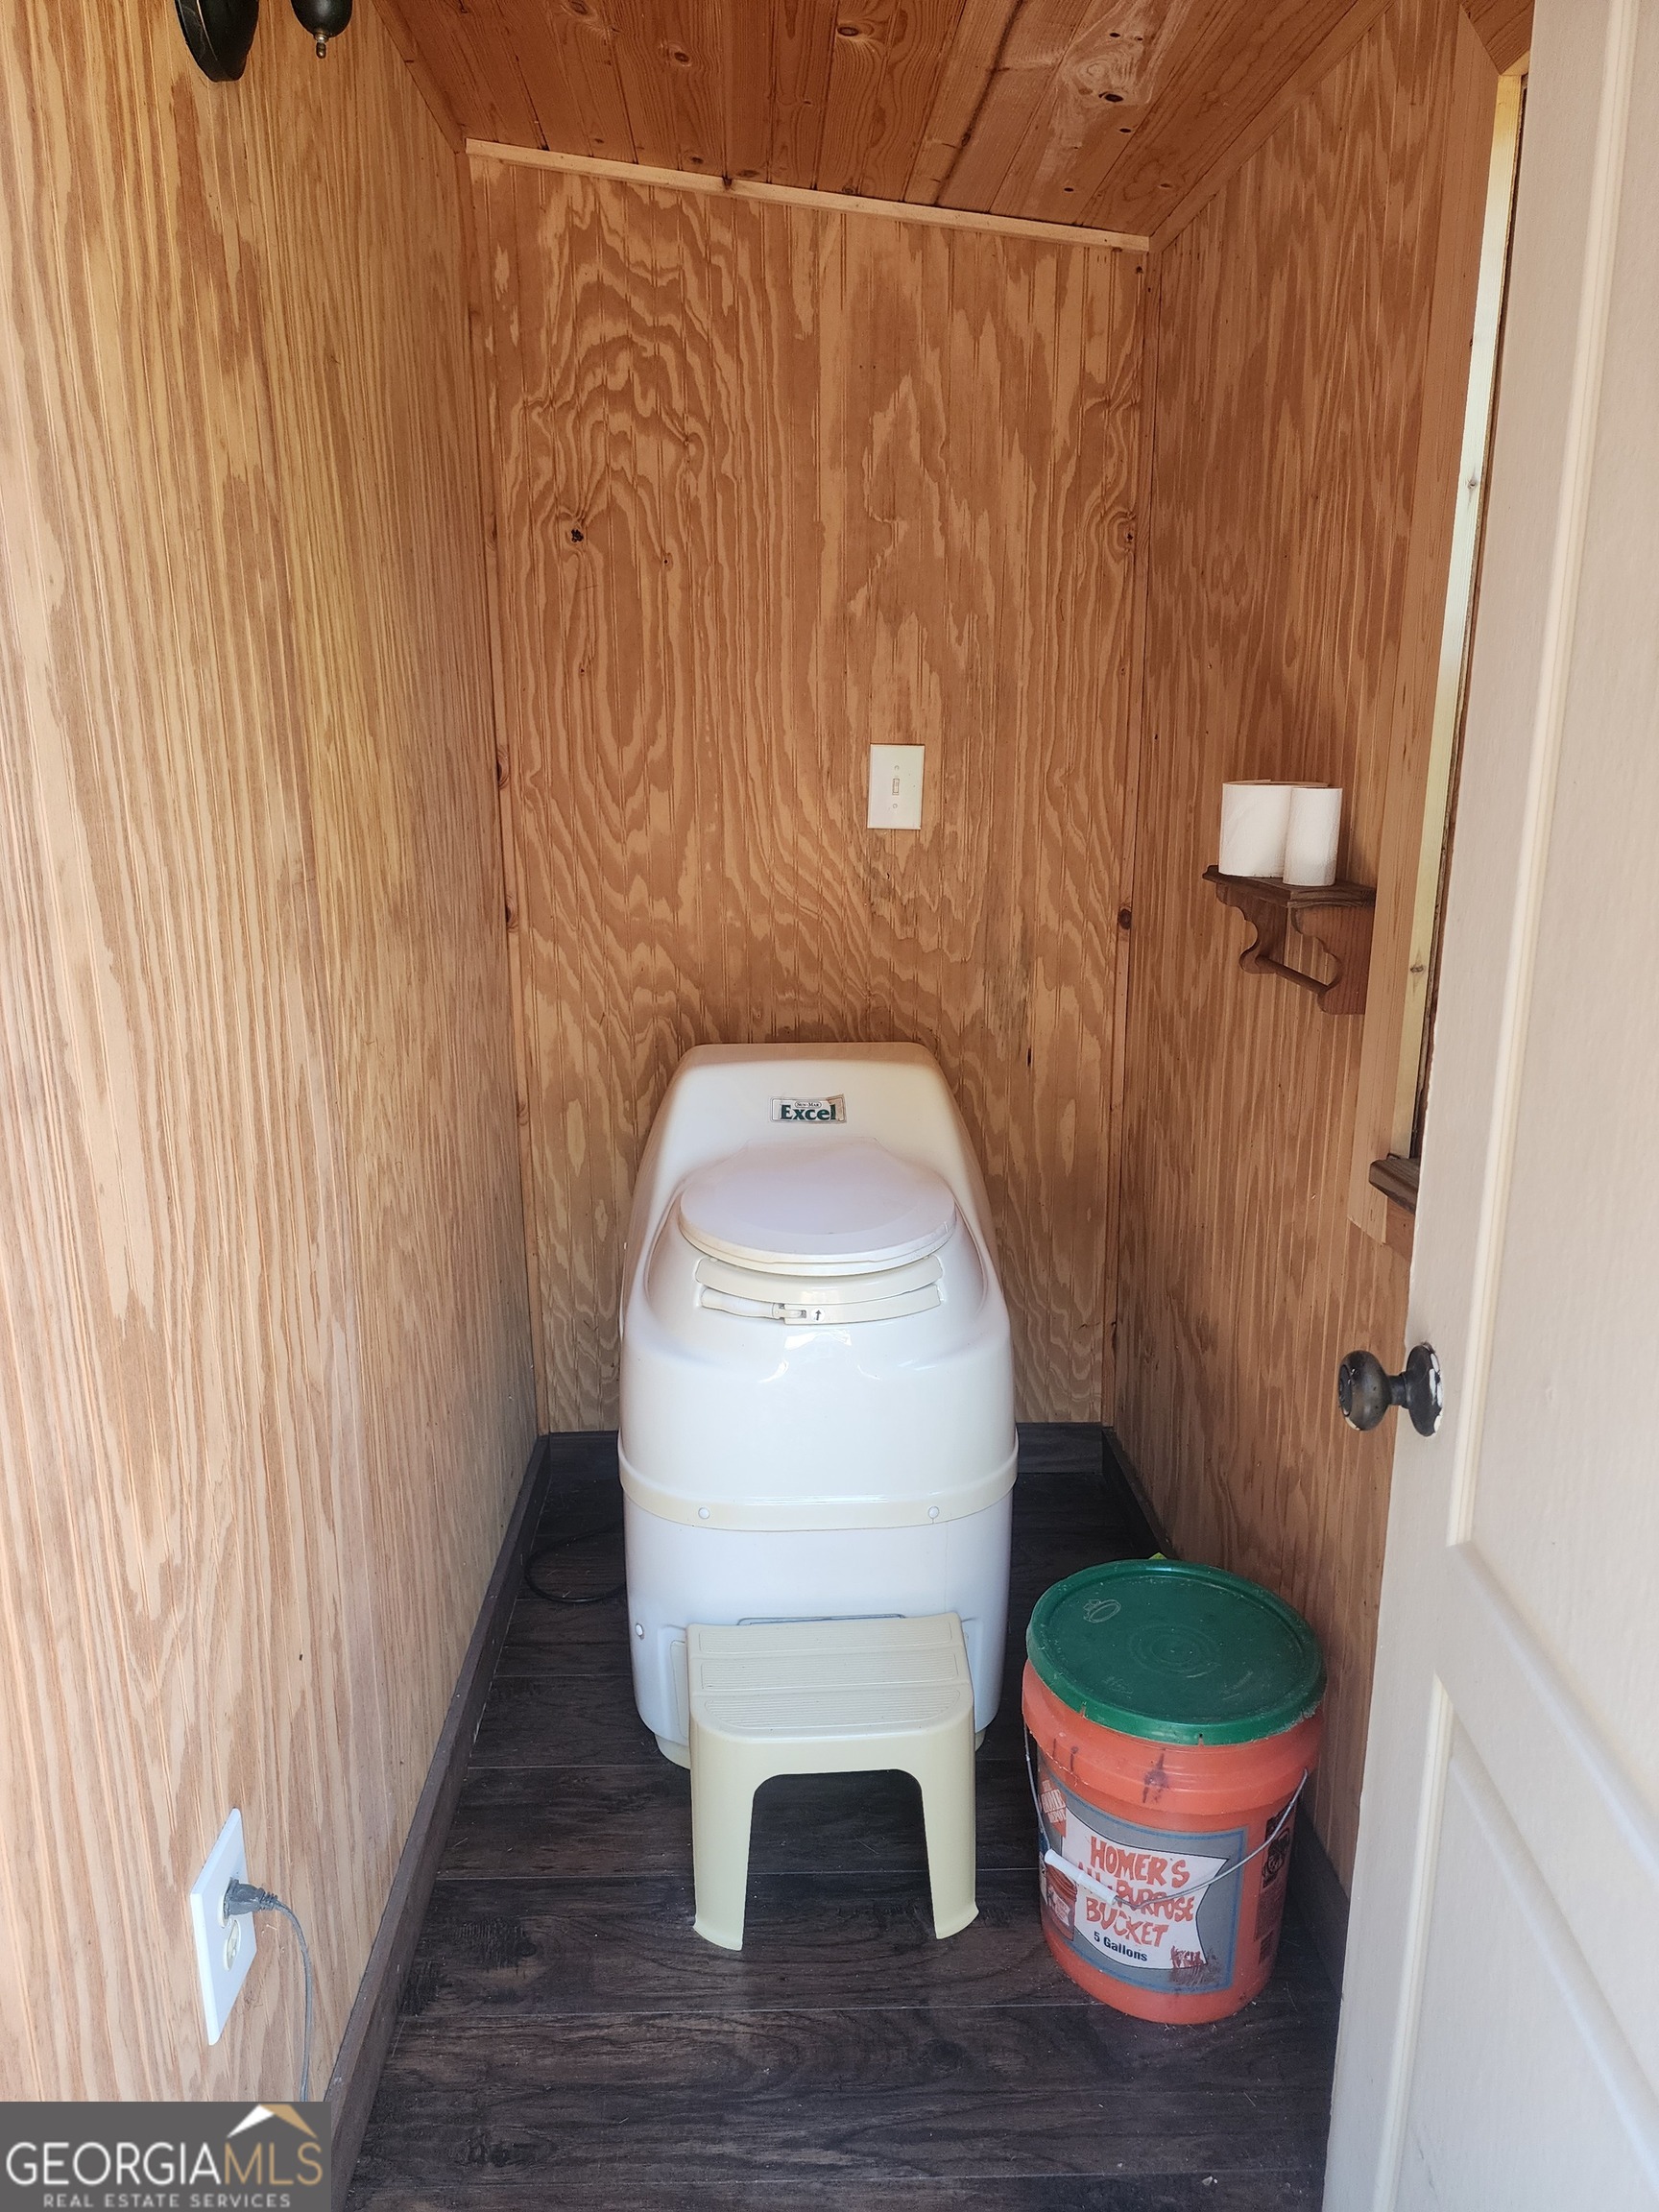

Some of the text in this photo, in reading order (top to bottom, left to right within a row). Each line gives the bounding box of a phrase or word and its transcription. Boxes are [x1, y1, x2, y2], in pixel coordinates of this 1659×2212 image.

[780, 1104, 836, 1120] Excel
[1090, 1836, 1190, 1888] HOMER'S
[1086, 1896, 1169, 1947] BUCKET
[1094, 1930, 1148, 1962] 5 Gallons
